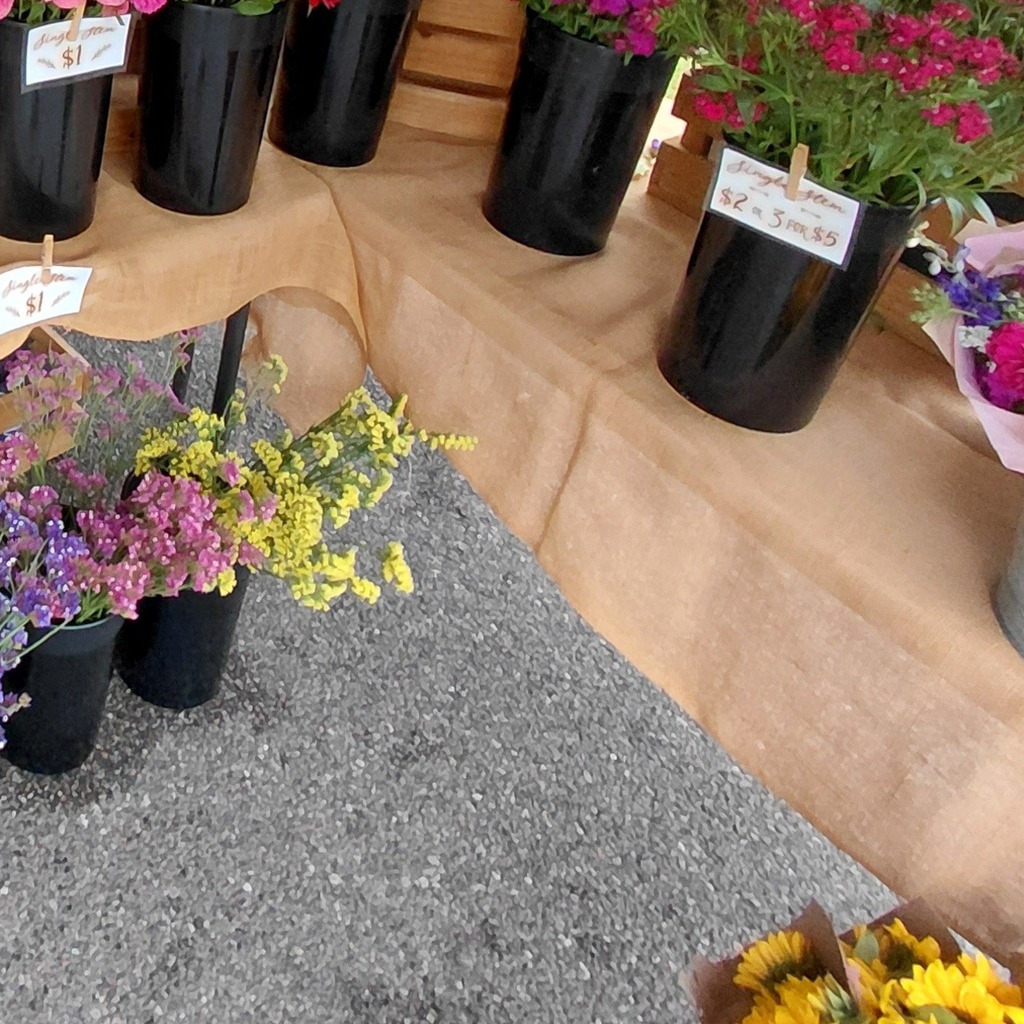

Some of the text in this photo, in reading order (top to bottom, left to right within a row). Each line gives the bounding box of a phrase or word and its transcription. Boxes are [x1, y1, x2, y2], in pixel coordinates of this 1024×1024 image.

[62, 44, 82, 69] $1
[719, 186, 748, 212] $2
[768, 208, 785, 228] 3
[786, 218, 809, 241] FOR
[811, 226, 840, 247] $5
[26, 291, 44, 316] $1
